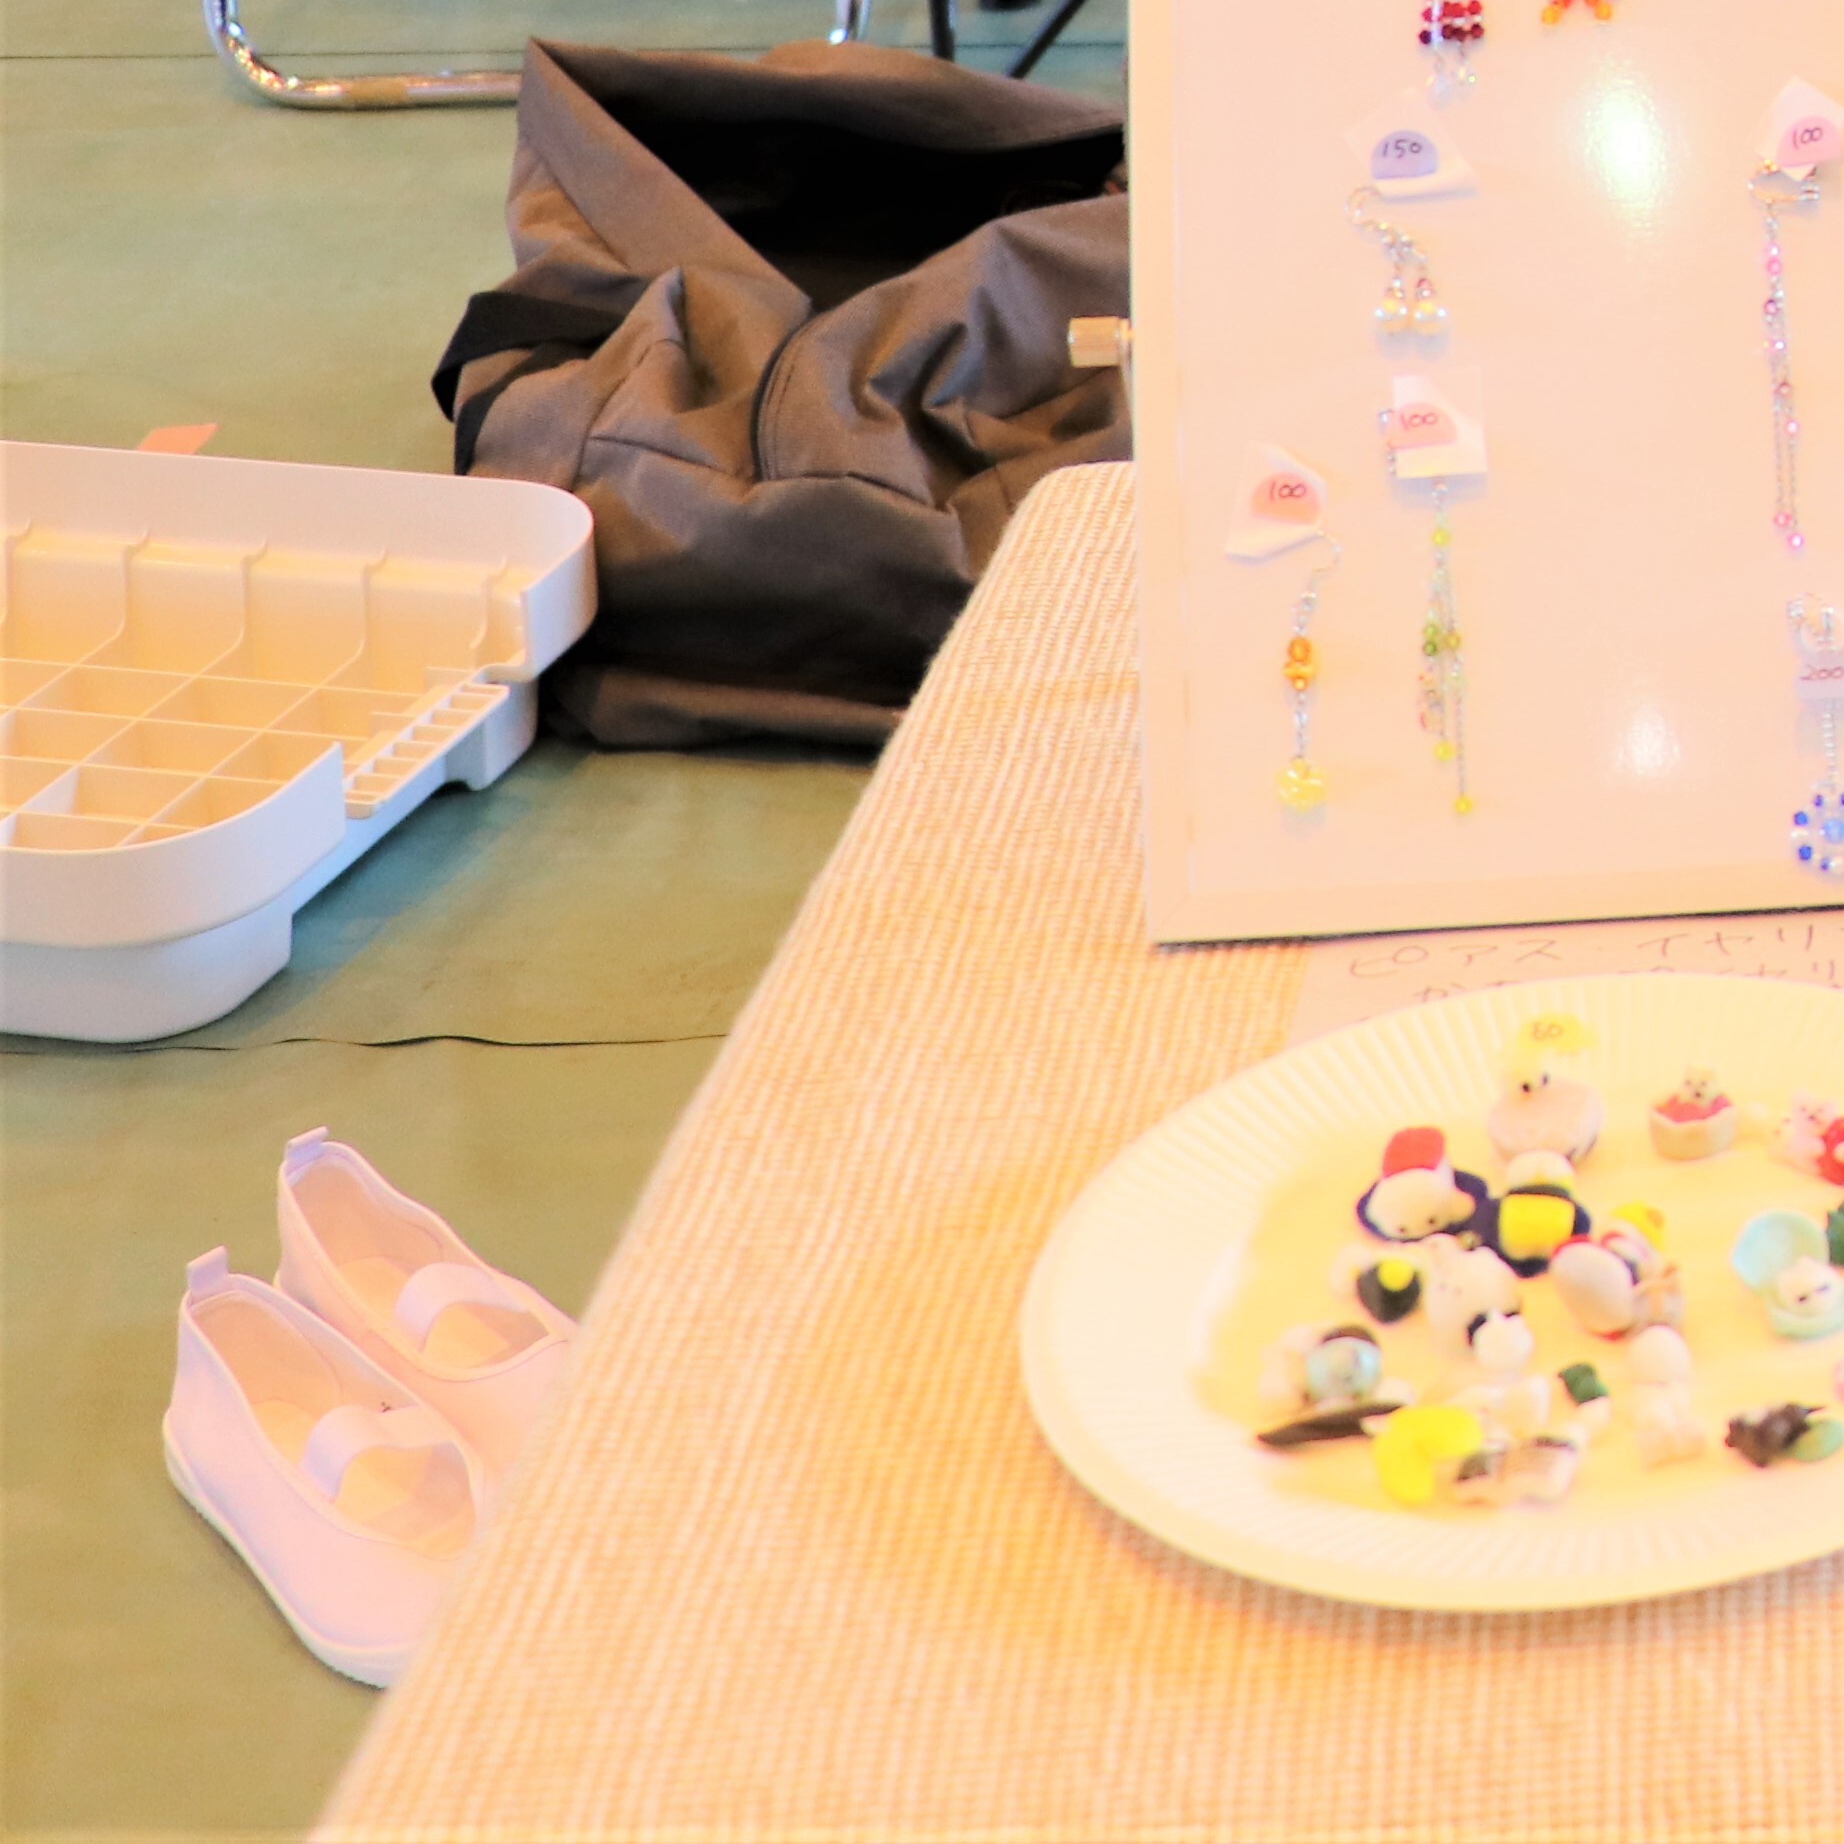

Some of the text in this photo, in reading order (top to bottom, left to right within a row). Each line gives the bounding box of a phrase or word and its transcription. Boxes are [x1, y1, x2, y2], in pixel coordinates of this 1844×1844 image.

[1790, 124, 1825, 147] 100
[1381, 138, 1424, 159] 150
[1400, 410, 1438, 432] 100
[1268, 479, 1308, 502] 100
